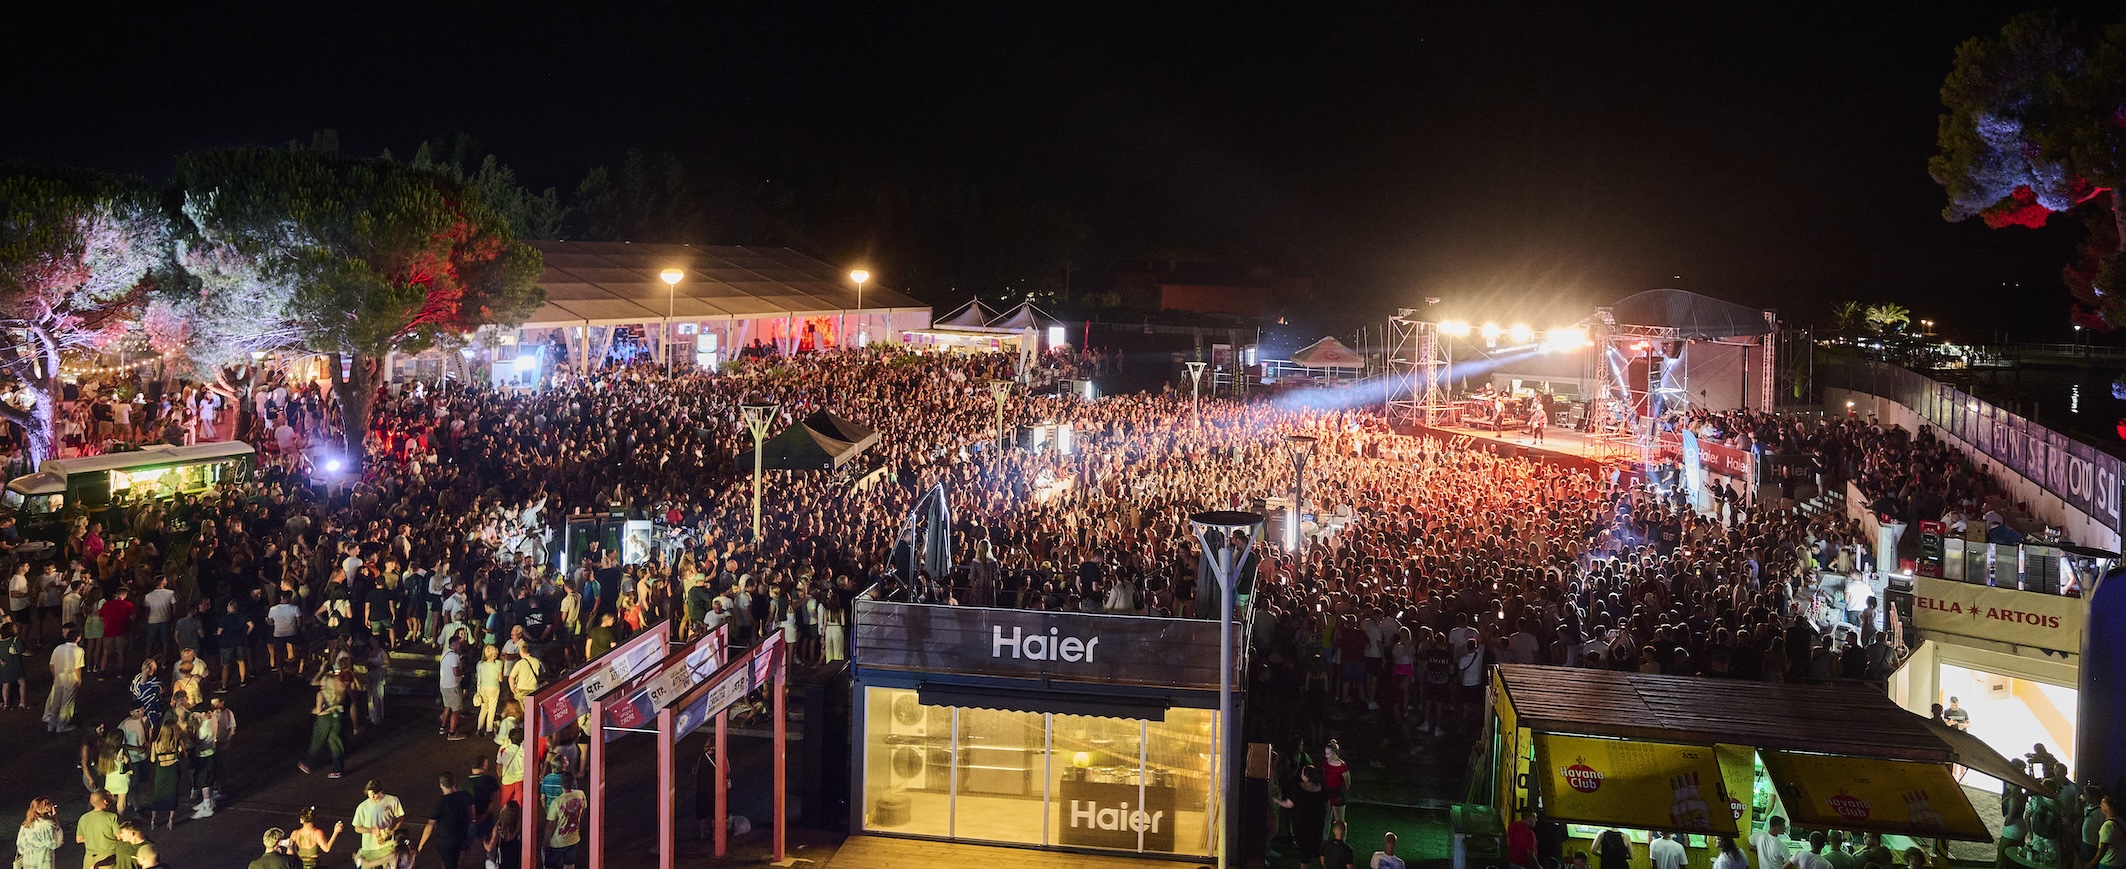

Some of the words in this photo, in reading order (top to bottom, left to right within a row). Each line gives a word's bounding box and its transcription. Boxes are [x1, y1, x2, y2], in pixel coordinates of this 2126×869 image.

[1664, 441, 1684, 456] Haie
[1993, 422, 2020, 460] FUN
[1698, 448, 1719, 464] Haier
[1770, 463, 1809, 478] Hier
[1912, 595, 1963, 615] TELLA
[1985, 607, 2060, 629] ARTOIS
[992, 625, 1099, 663] Haier
[1559, 766, 1605, 780] Havana
[1570, 777, 1597, 790] Club
[1730, 802, 1748, 811] ana
[1824, 795, 1872, 810] Havana
[1070, 799, 1163, 834] Haier
[1837, 806, 1867, 818] Club
